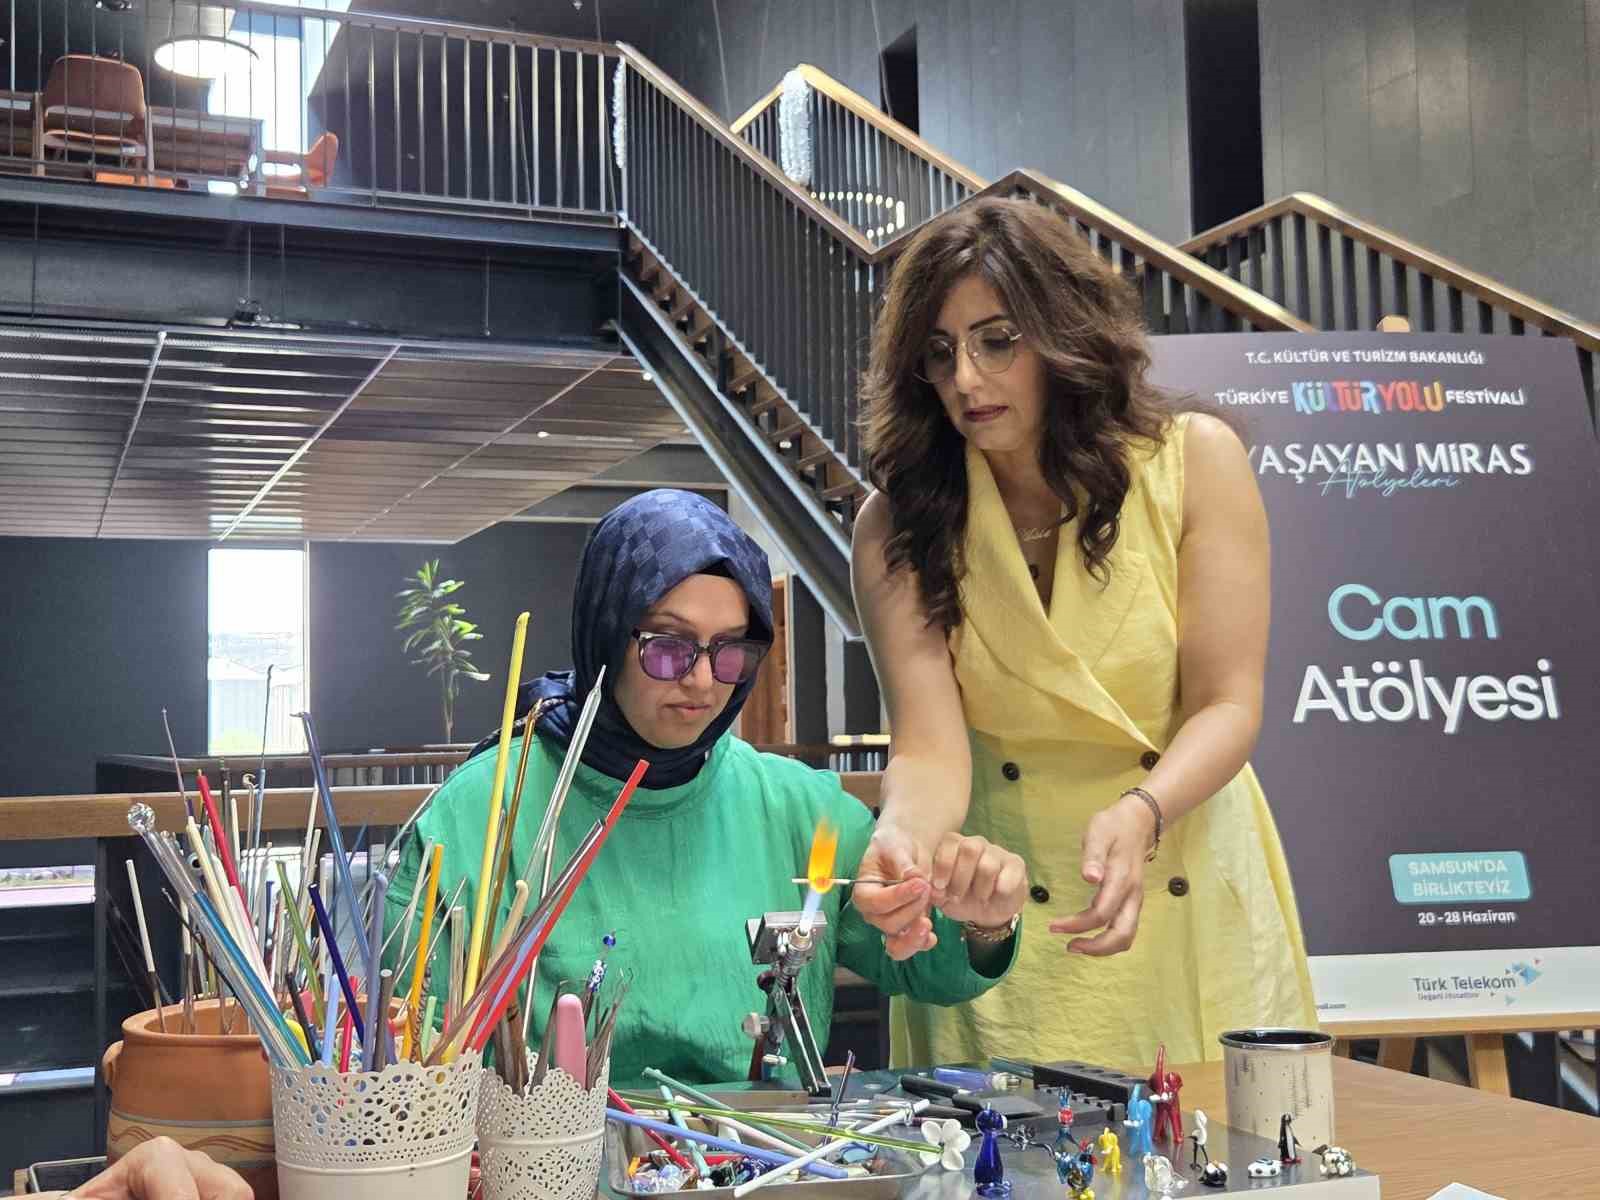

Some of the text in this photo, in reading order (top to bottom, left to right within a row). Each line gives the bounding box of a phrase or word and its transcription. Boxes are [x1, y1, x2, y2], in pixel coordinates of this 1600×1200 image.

[1246, 349, 1483, 365] T.C. KÜLTÜR VE TURİZM BAKANLIĞI
[1215, 389, 1289, 405] TÜRKİYE
[1446, 387, 1525, 406] FESTİVALİ
[1415, 442, 1533, 476] MİRAS
[1328, 584, 1498, 640] Cam
[1293, 659, 1558, 734] Atölyesi
[1408, 859, 1507, 876] SAMSUN'DA
[1413, 877, 1512, 897] BİRLİKTEYİZ
[1412, 976, 1516, 991] Türk Telekom
